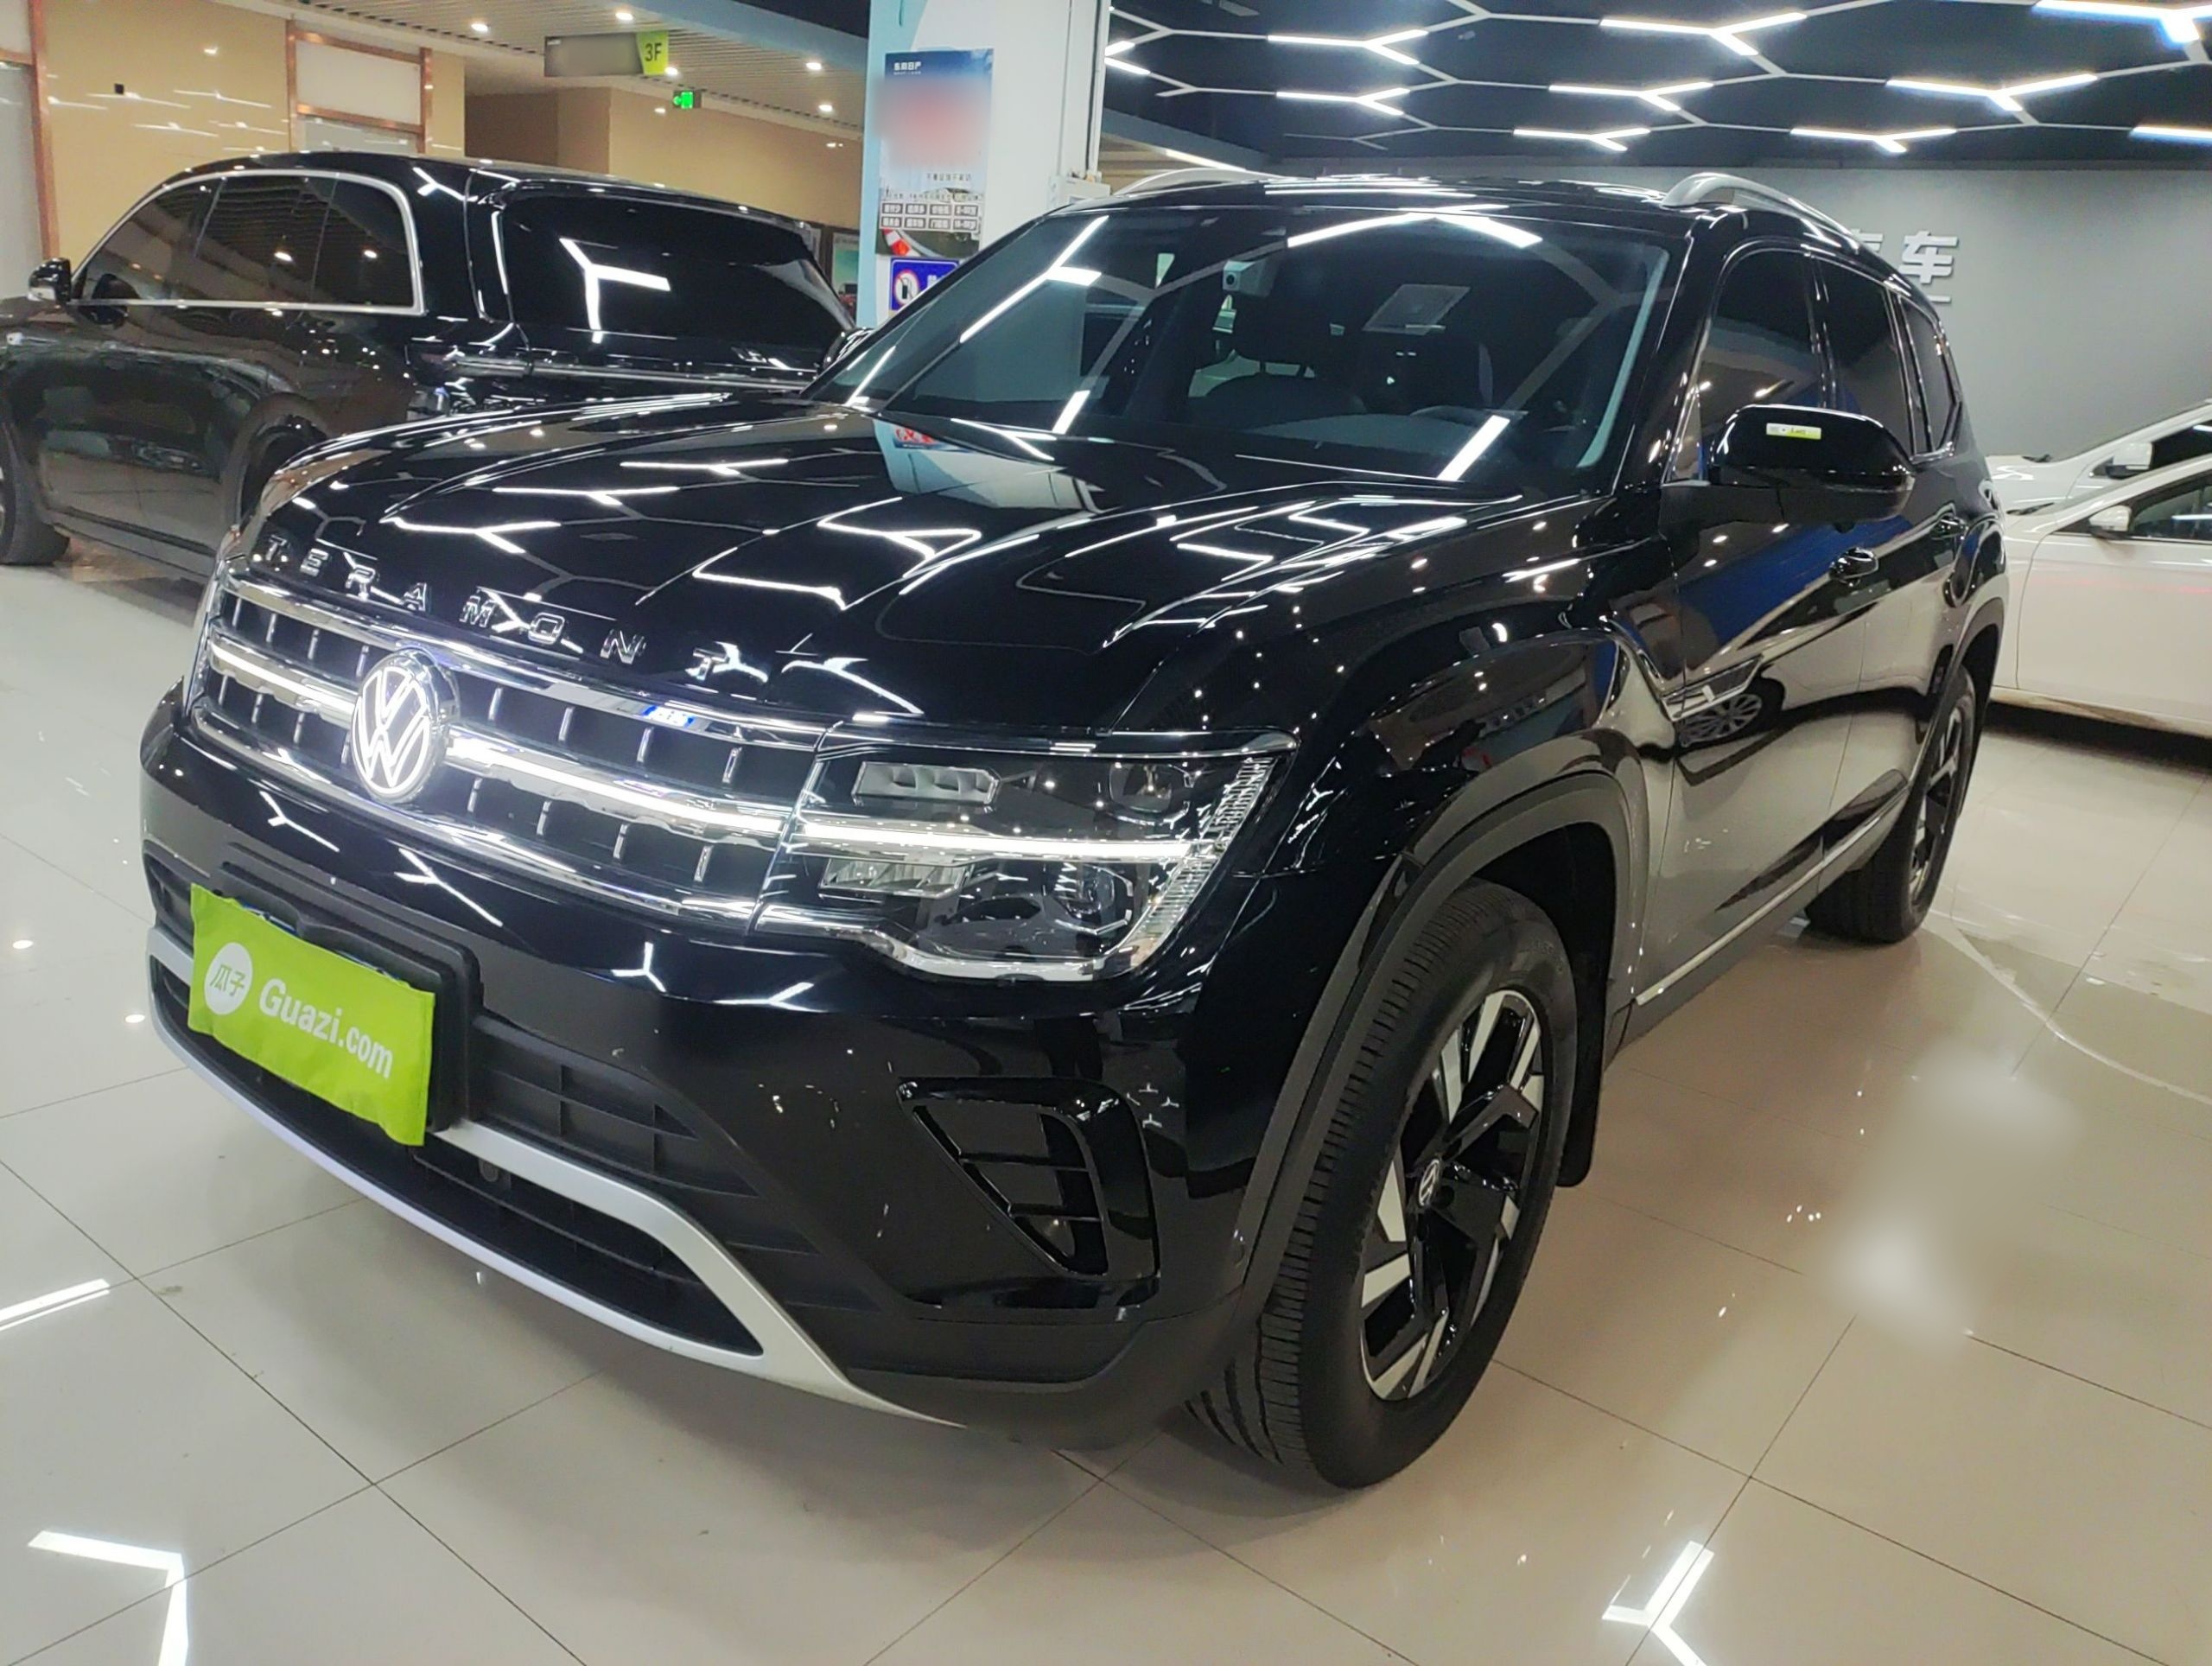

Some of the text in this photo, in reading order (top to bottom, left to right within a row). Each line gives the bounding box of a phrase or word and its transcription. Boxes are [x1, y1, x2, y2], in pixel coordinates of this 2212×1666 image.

[644, 41, 663, 62] 3F
[264, 534, 728, 682] TERAMONT
[209, 963, 247, 997] 瓜子
[258, 977, 394, 1079] Guazi.com
